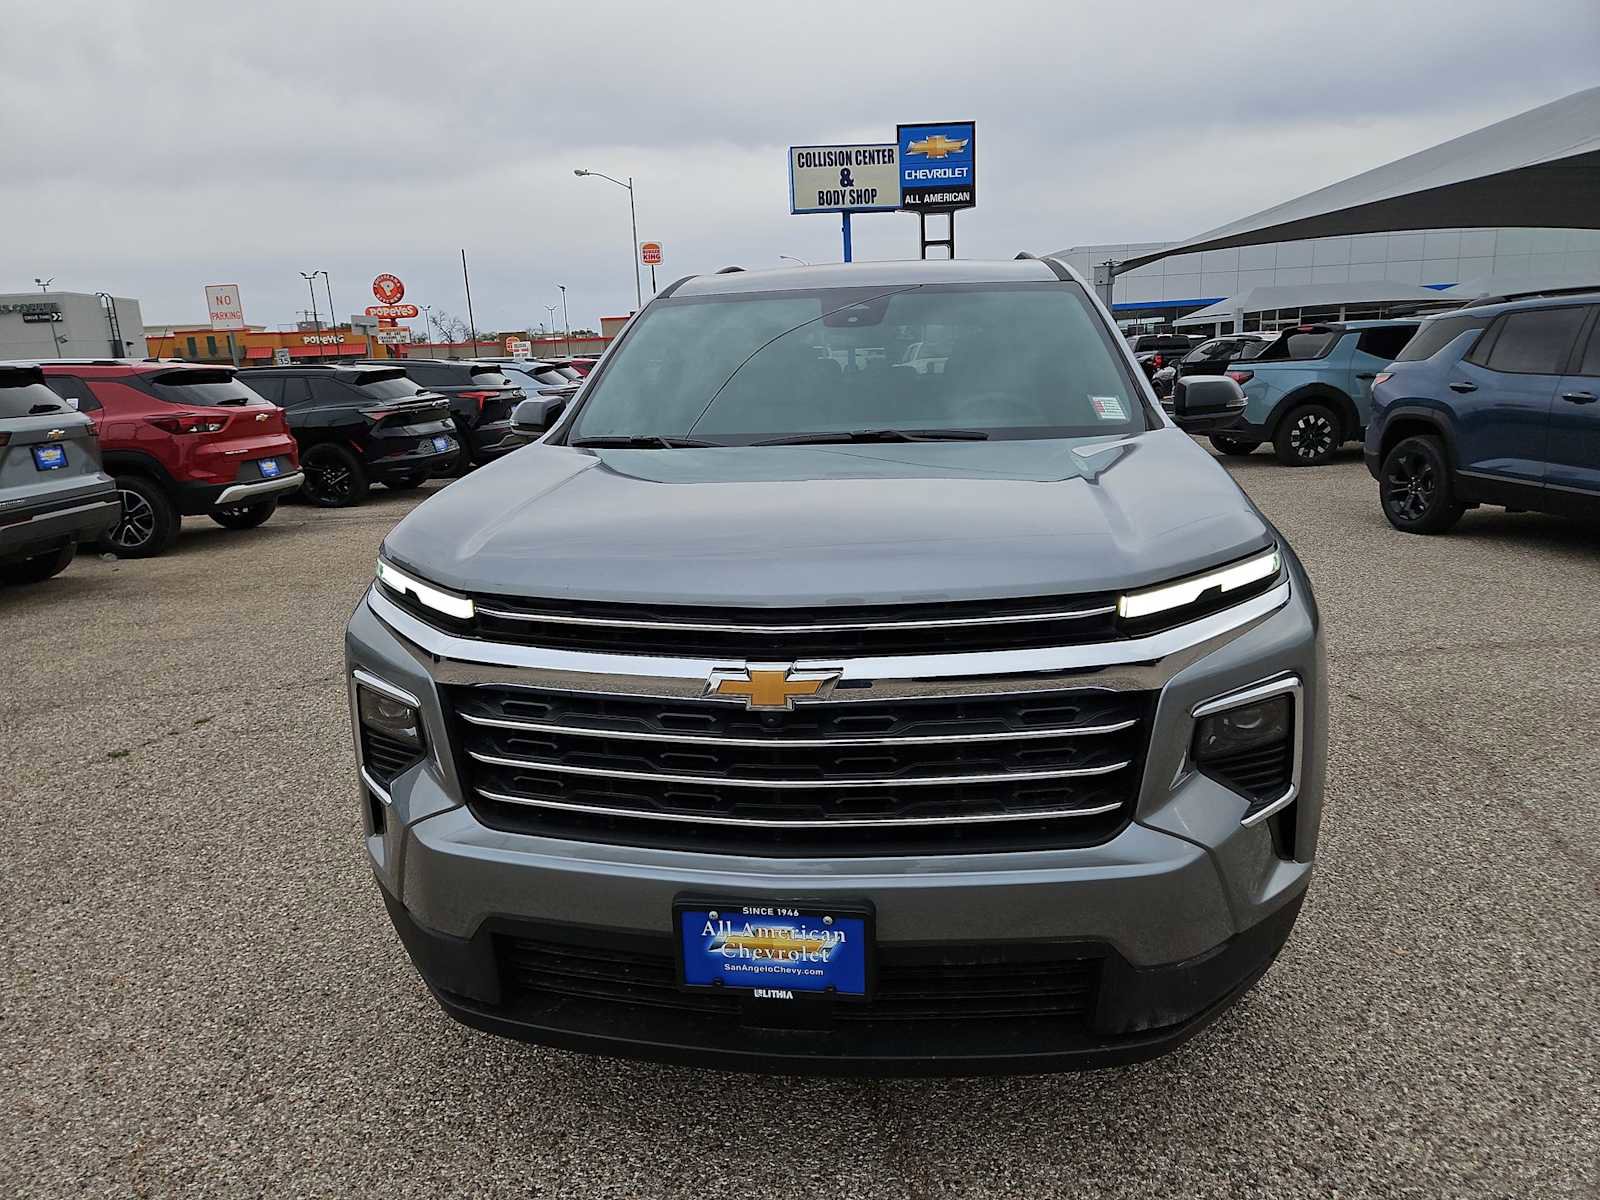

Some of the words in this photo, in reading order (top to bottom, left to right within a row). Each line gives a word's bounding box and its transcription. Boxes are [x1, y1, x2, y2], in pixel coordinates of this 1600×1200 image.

[797, 150, 852, 168] COLLISION
[855, 148, 895, 165] CENTER
[839, 167, 855, 188] &
[905, 167, 969, 180] CHEVROLET
[817, 189, 848, 206] BODY
[849, 188, 878, 205] SHOP
[905, 194, 921, 204] ALL
[923, 191, 970, 203] AMERICAN
[215, 295, 231, 306] NO
[211, 310, 241, 321] PARKING
[742, 906, 774, 916] SINCE
[777, 908, 800, 917] 1946
[701, 920, 731, 936] All
[742, 922, 847, 943] American
[721, 942, 832, 963] Chevrolet
[724, 963, 824, 976] SanAngeloChevy.com
